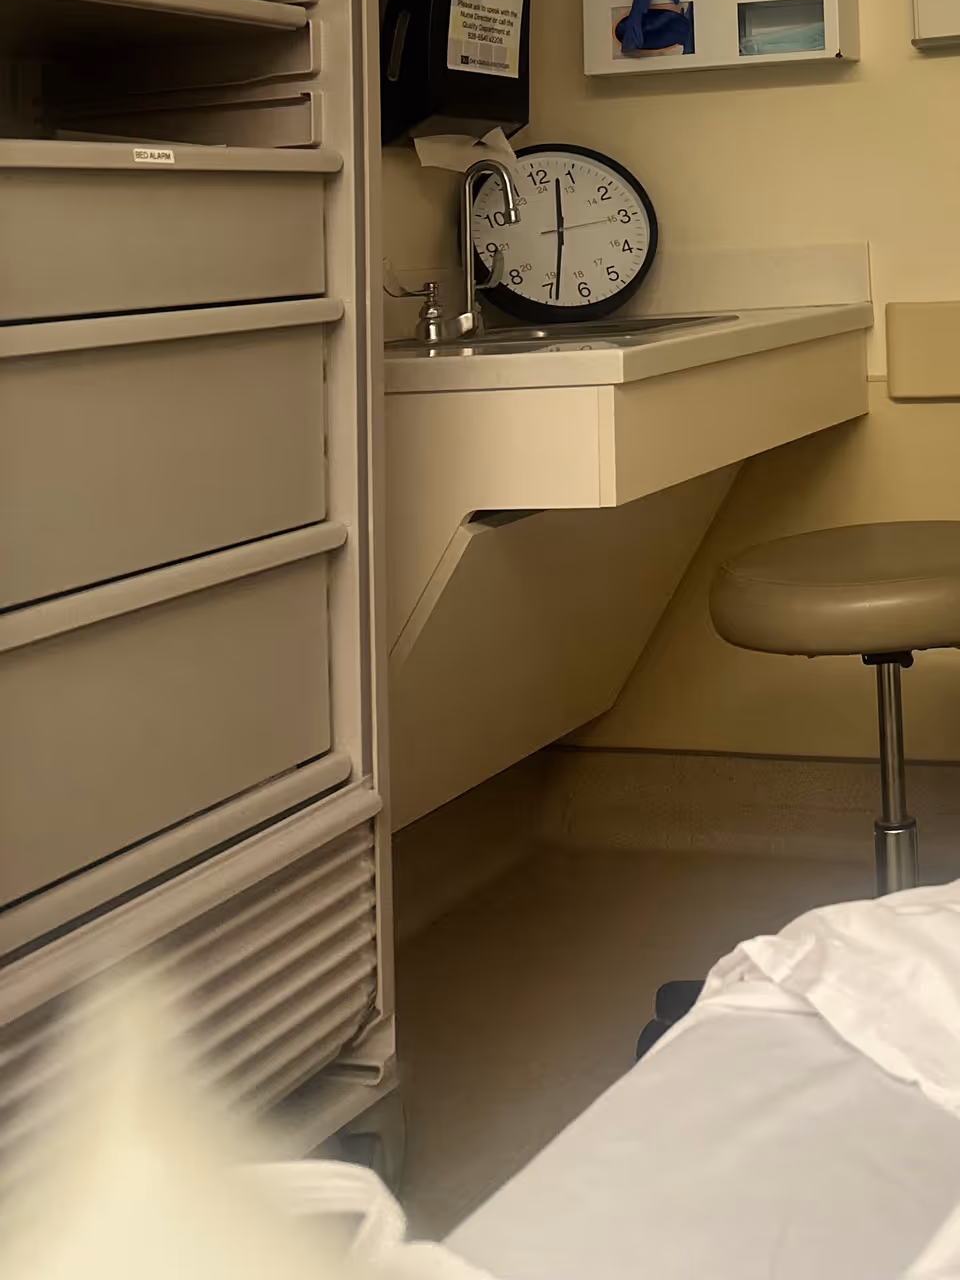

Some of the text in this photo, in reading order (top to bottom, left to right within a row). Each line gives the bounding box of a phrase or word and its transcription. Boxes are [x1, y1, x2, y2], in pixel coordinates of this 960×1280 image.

[457, 0, 472, 8] Please
[460, 10, 473, 19] Nurse
[474, 13, 492, 23] Director
[462, 21, 478, 30] Quality
[479, 24, 505, 35] Department
[135, 151, 171, 160] BED ALARM
[527, 170, 551, 186] 12
[565, 170, 575, 184] 1
[597, 185, 612, 201] 2
[587, 198, 597, 207] 14
[484, 211, 506, 228] 10
[617, 209, 631, 224] 3
[610, 240, 620, 248] 16
[622, 239, 634, 253] 4
[520, 263, 532, 272] 20
[593, 258, 603, 266] 17
[509, 269, 523, 285] 8
[545, 272, 556, 280] 19
[573, 270, 584, 279] 18
[606, 265, 620, 282] 5
[542, 282, 554, 299] 7
[577, 282, 591, 298] 6
